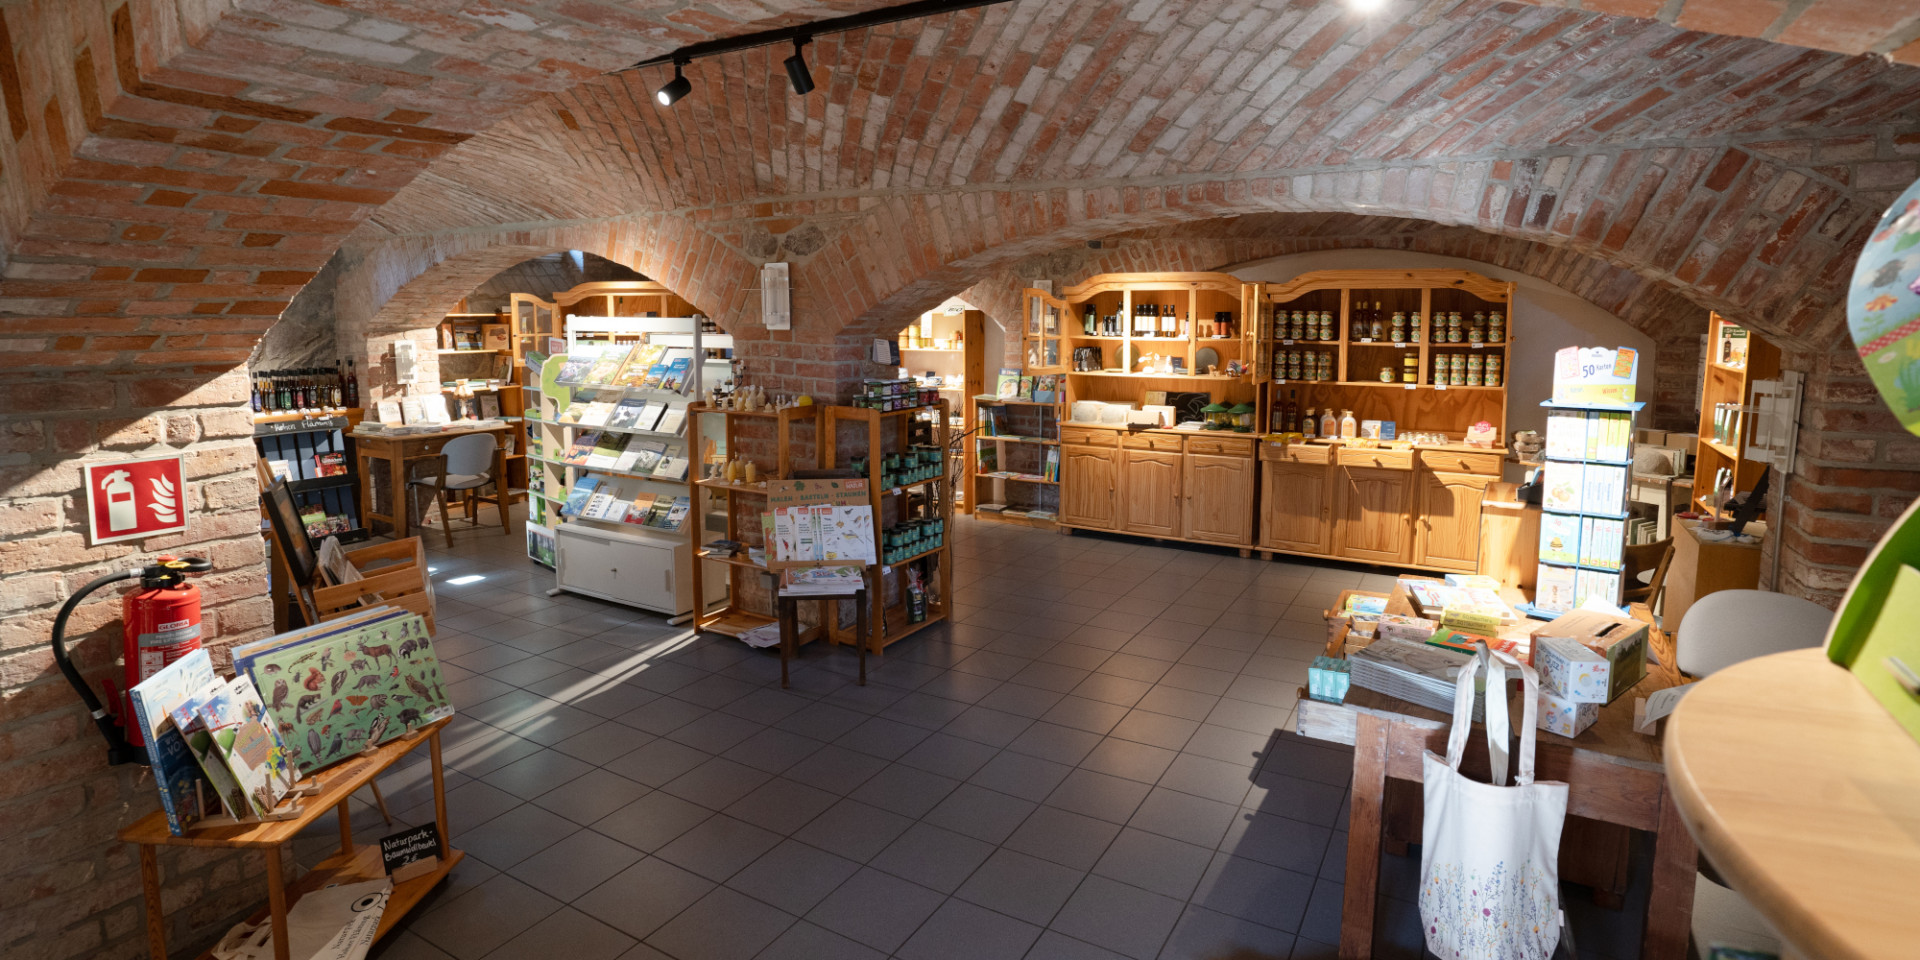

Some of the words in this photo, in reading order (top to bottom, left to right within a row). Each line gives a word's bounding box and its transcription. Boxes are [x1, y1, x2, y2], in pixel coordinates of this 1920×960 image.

[1582, 364, 1595, 379] 50
[800, 493, 829, 501] BASTELN
[835, 490, 867, 499] STAUNEN
[158, 619, 189, 631] GLORIA
